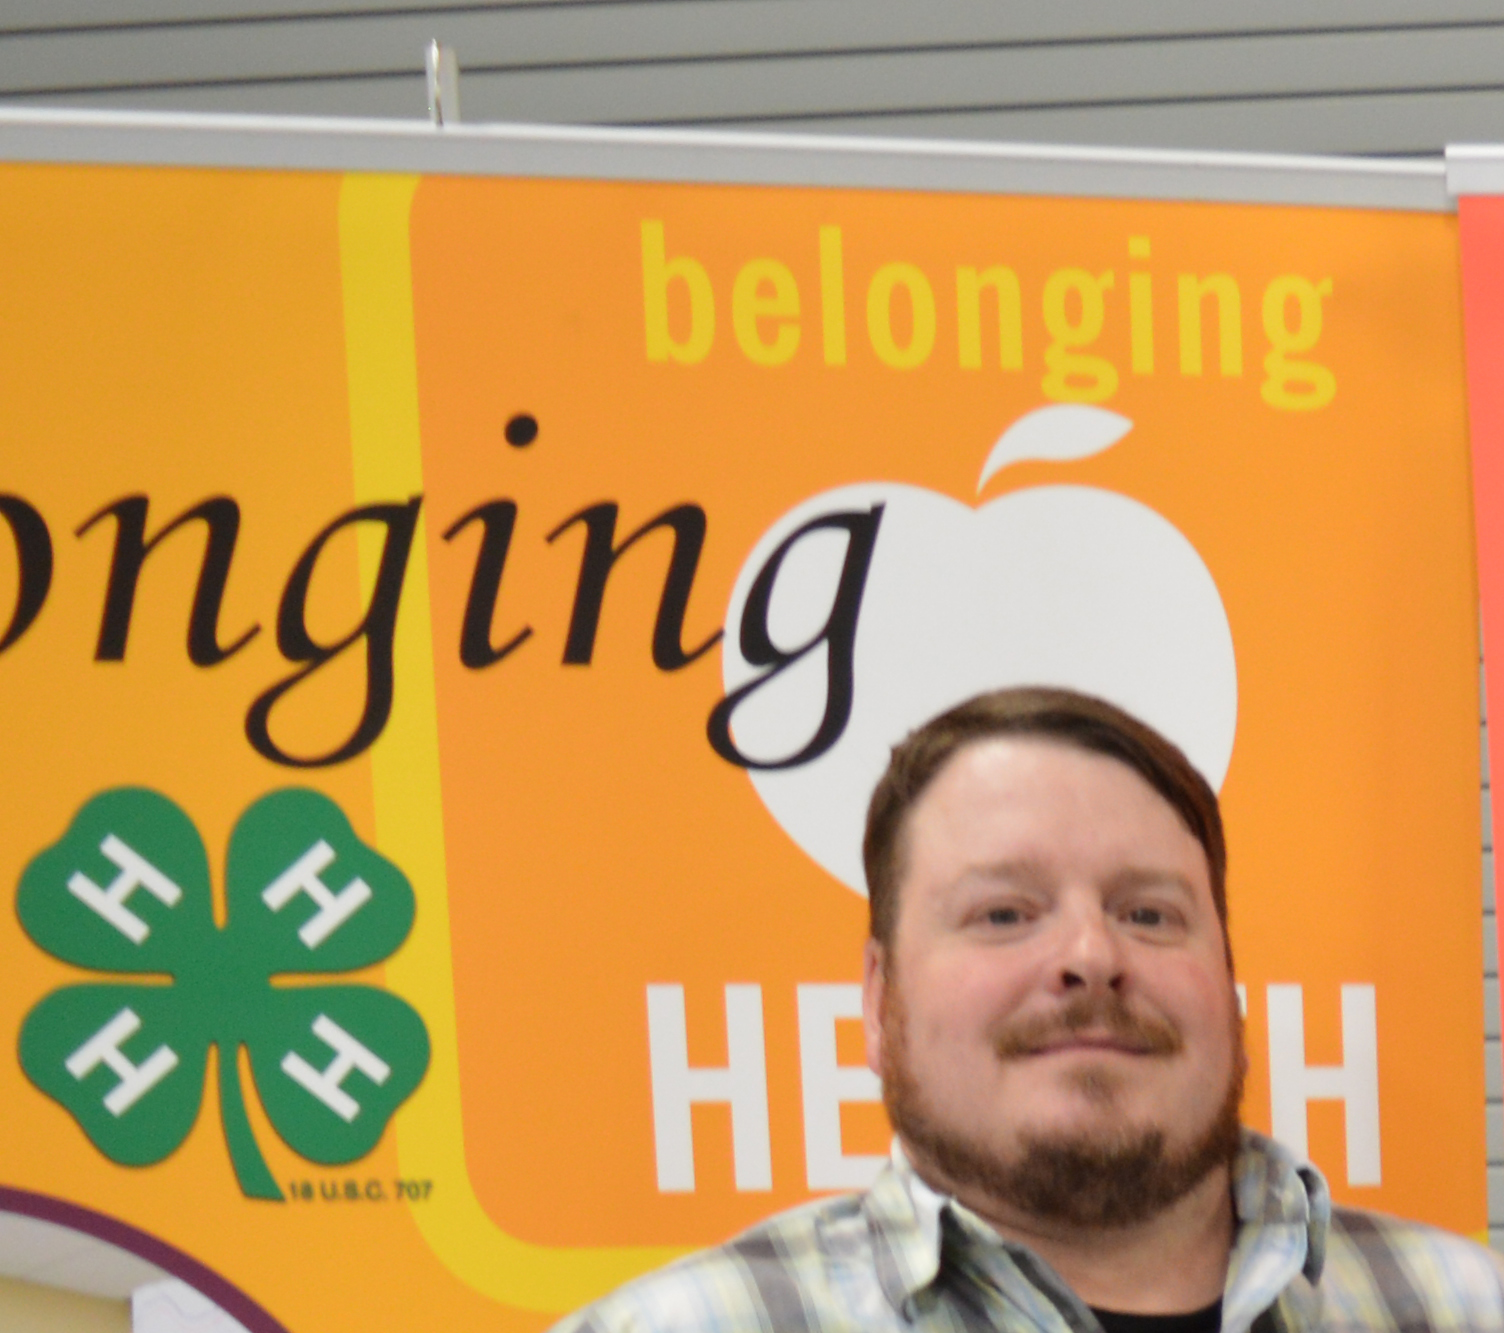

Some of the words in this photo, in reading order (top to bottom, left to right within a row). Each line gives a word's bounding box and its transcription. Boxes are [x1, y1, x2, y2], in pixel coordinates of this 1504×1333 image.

[641, 219, 1337, 411] belonging
[67, 833, 182, 945] H
[261, 839, 372, 950] H
[66, 1007, 178, 1116] H
[280, 1013, 391, 1122] H
[645, 983, 1381, 1192] HEH
